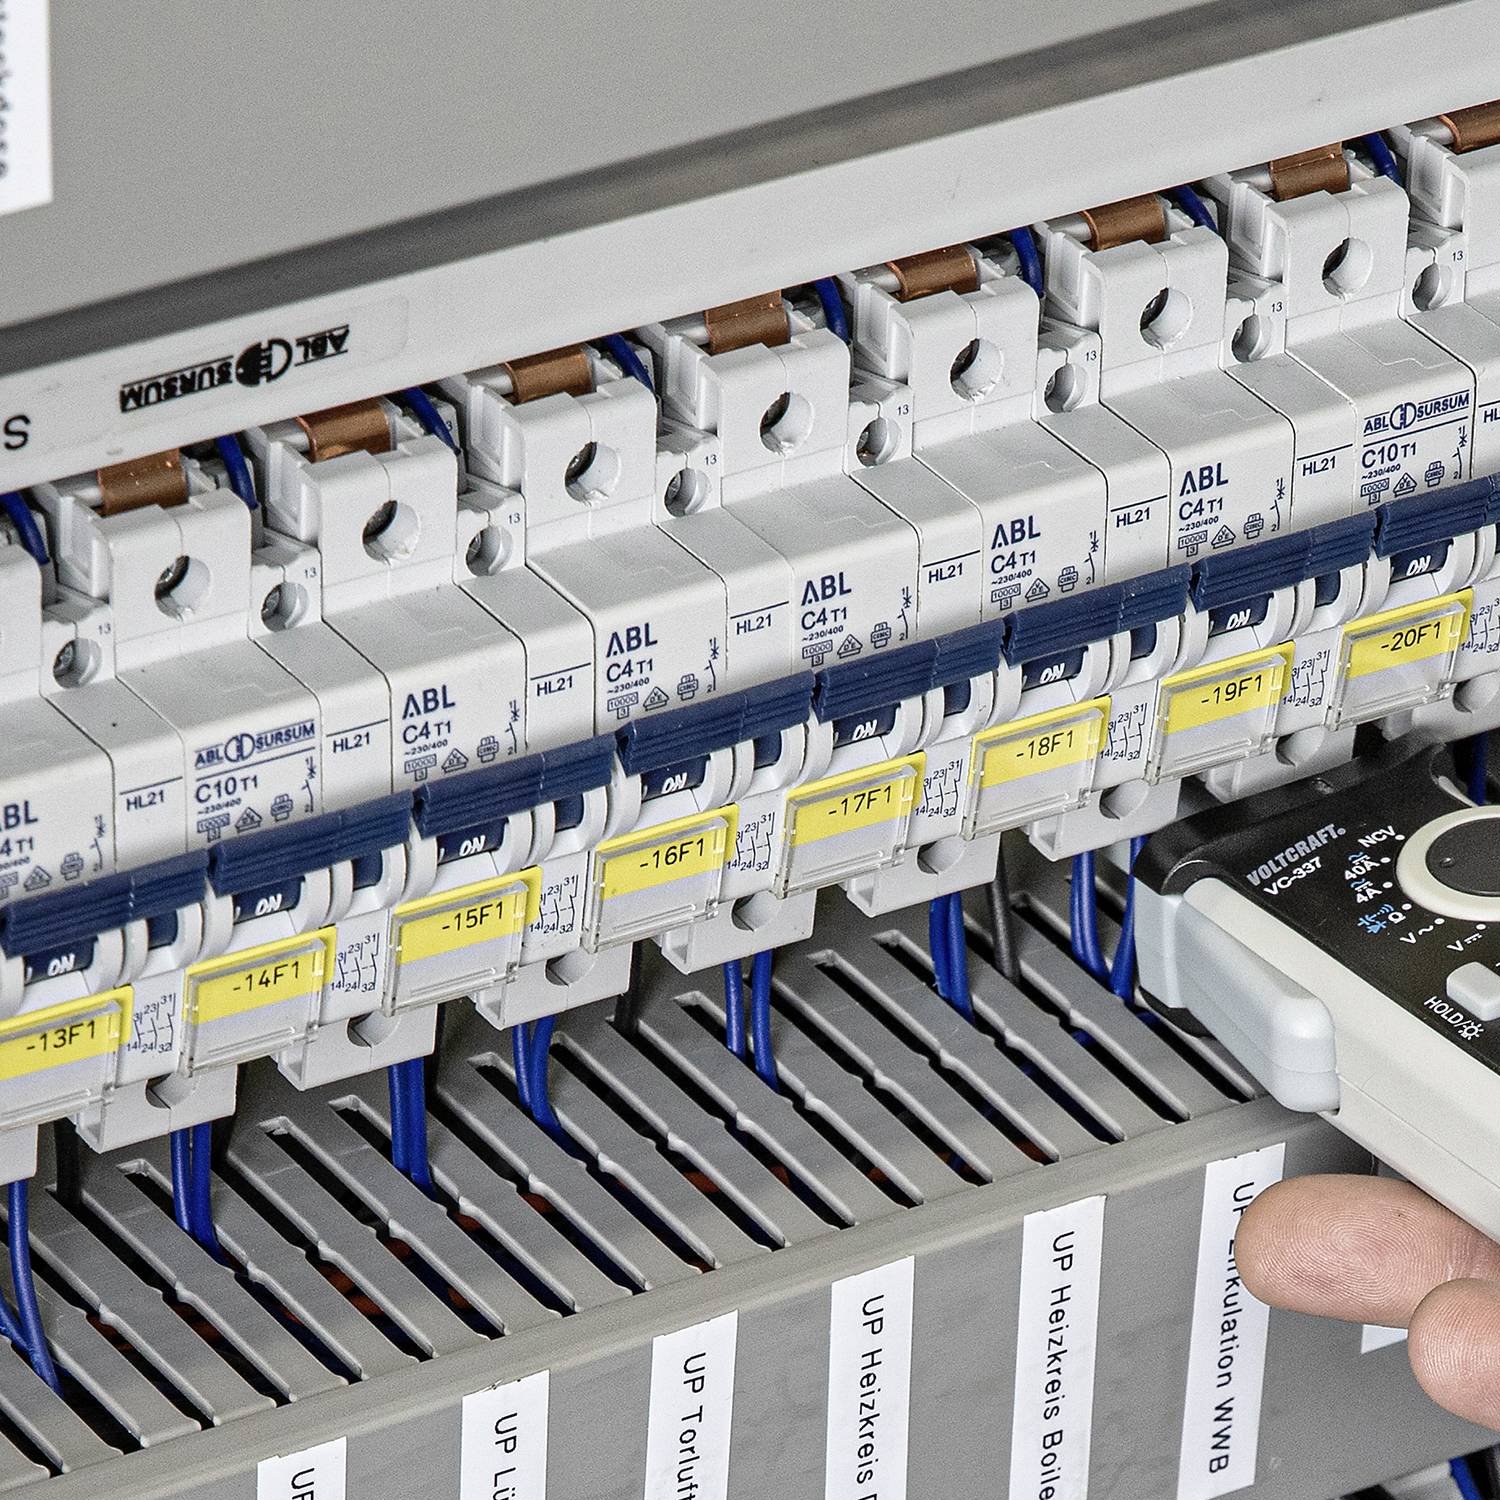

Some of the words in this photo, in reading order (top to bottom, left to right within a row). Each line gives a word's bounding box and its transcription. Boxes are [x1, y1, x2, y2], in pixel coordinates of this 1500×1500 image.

[1364, 416, 1388, 434] ABL
[1417, 393, 1469, 418] SURSUM
[1302, 456, 1336, 476] HL21
[1361, 447, 1398, 468] C10
[1179, 463, 1228, 496] ABL
[1116, 508, 1150, 528] HL21
[1179, 501, 1204, 520] C4
[991, 515, 1041, 549] ABL
[991, 555, 1017, 574] C4
[800, 572, 852, 606] ABL
[736, 614, 772, 635] HL21
[801, 611, 828, 631] C4
[606, 622, 657, 657] ABL
[1381, 623, 1440, 651] -20F1
[536, 675, 573, 696] HL21
[606, 663, 633, 682] C4
[402, 686, 455, 719] ABL
[1201, 674, 1262, 704] -19F1
[194, 745, 224, 767] ABL
[256, 723, 315, 749] SURSUM
[333, 732, 370, 753] HL21
[403, 722, 431, 745] C4
[1016, 730, 1073, 759] -18F1
[127, 790, 164, 812] HL21
[194, 777, 237, 803] C10
[829, 785, 891, 816] -17F1
[1358, 826, 1396, 849] NCV
[639, 838, 705, 870] -16F1
[1264, 857, 1322, 898] VC-337
[1344, 858, 1381, 882] 40A
[1356, 884, 1382, 905] 4A
[442, 901, 504, 931] -15F1
[233, 961, 299, 992] -14F1
[27, 1020, 96, 1052] -13F1
[1052, 1231, 1074, 1272] UP
[862, 1294, 885, 1337] UP
[1043, 1284, 1071, 1421] Heizkreis
[683, 1351, 707, 1395] UP
[856, 1350, 883, 1485] Heizkreis
[494, 1412, 518, 1455] UP
[1208, 1397, 1235, 1475] WWB
